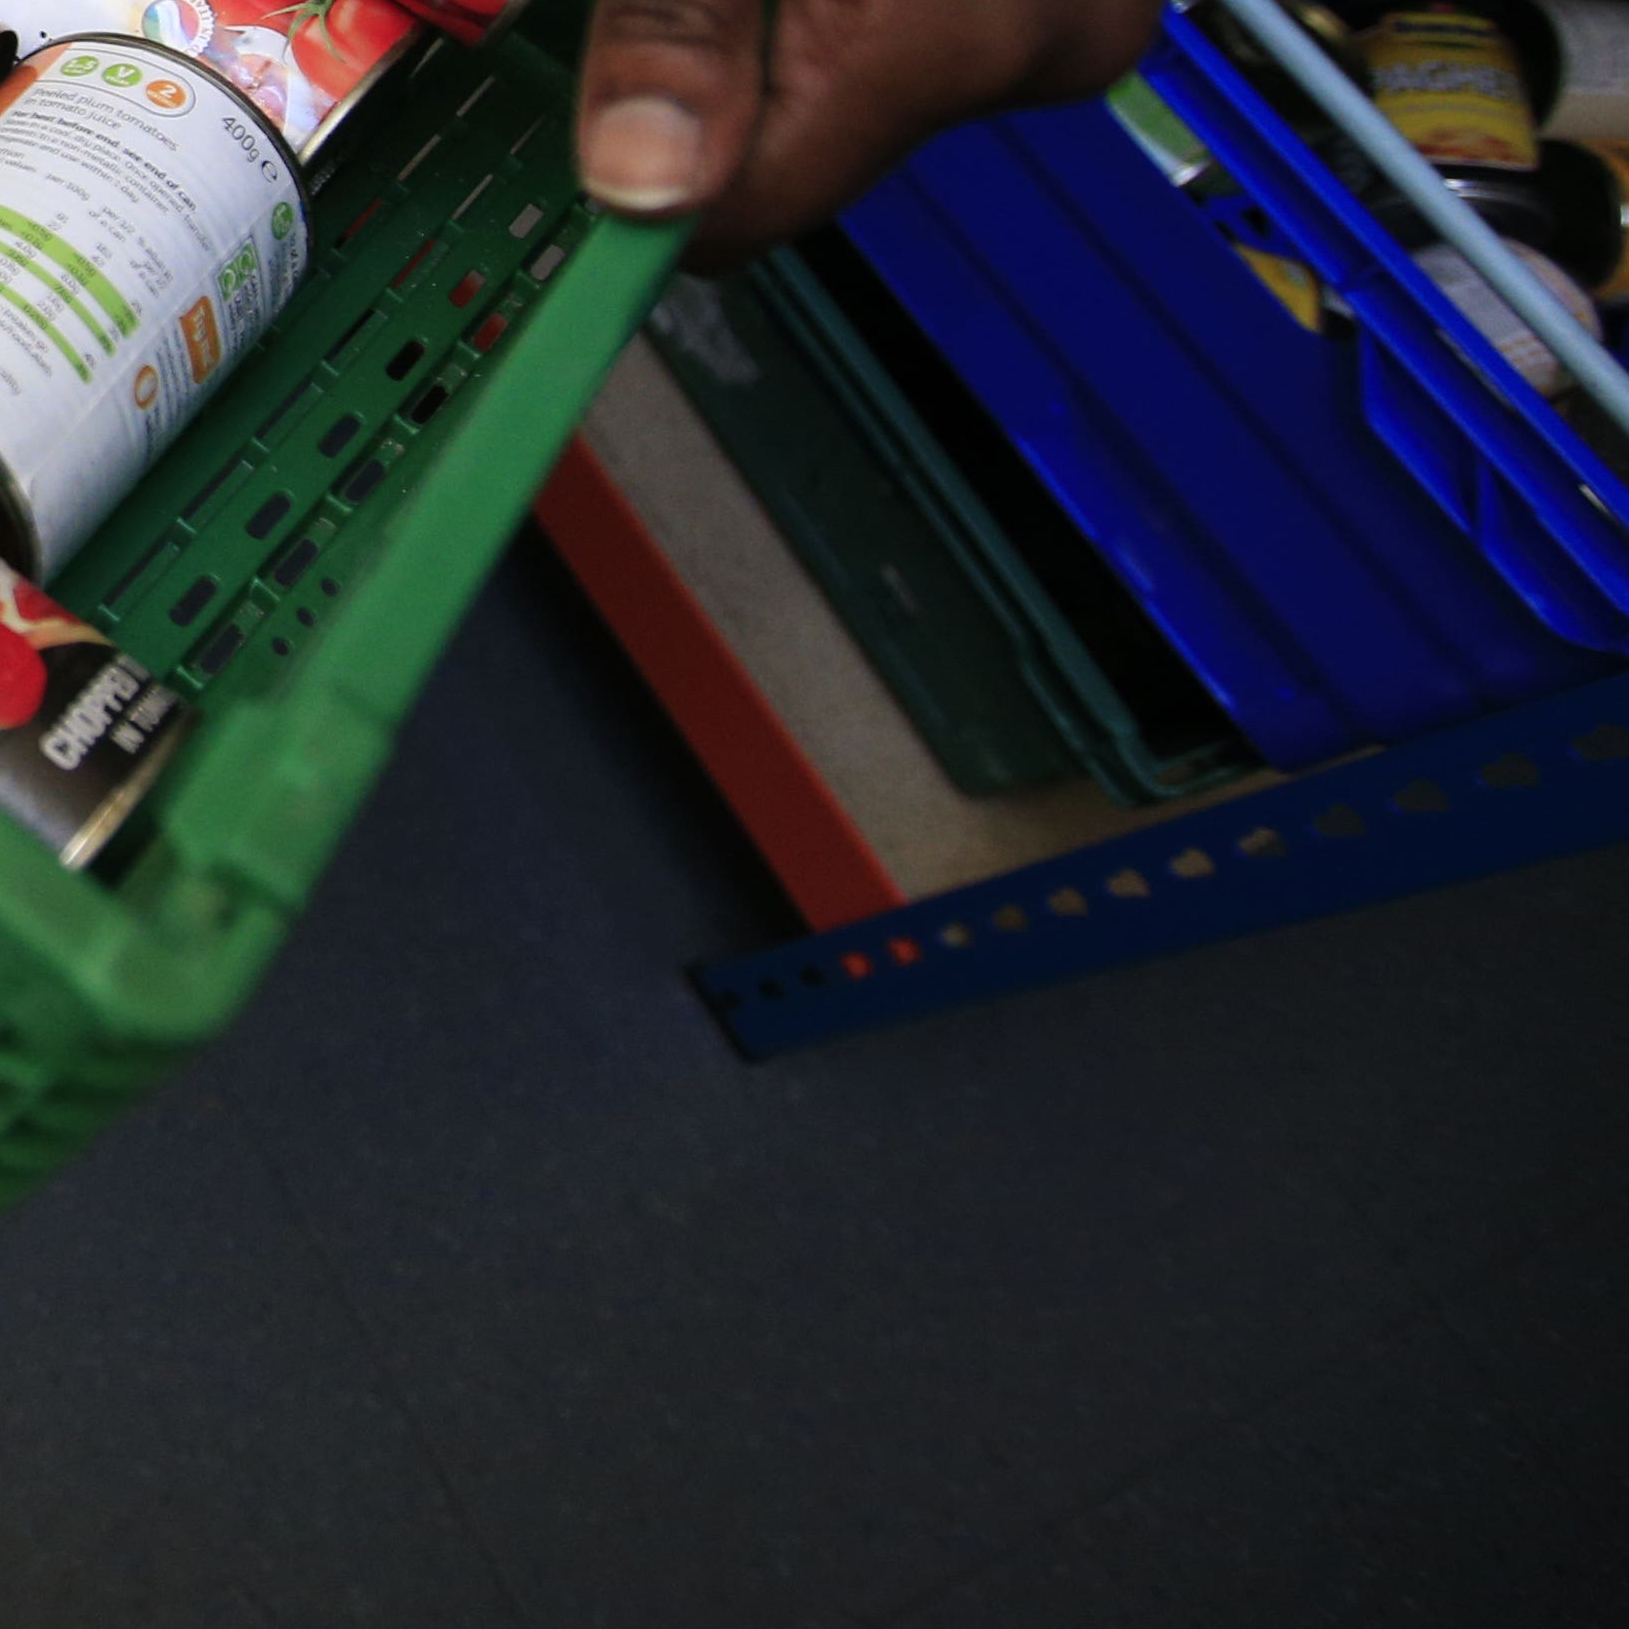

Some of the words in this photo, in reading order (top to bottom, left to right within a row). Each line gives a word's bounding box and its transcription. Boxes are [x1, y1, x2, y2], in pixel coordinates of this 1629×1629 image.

[37, 95, 86, 119] tomato
[78, 94, 116, 116] plum
[115, 111, 179, 151] tomatoes
[57, 116, 95, 137] before
[218, 113, 259, 164] 400g
